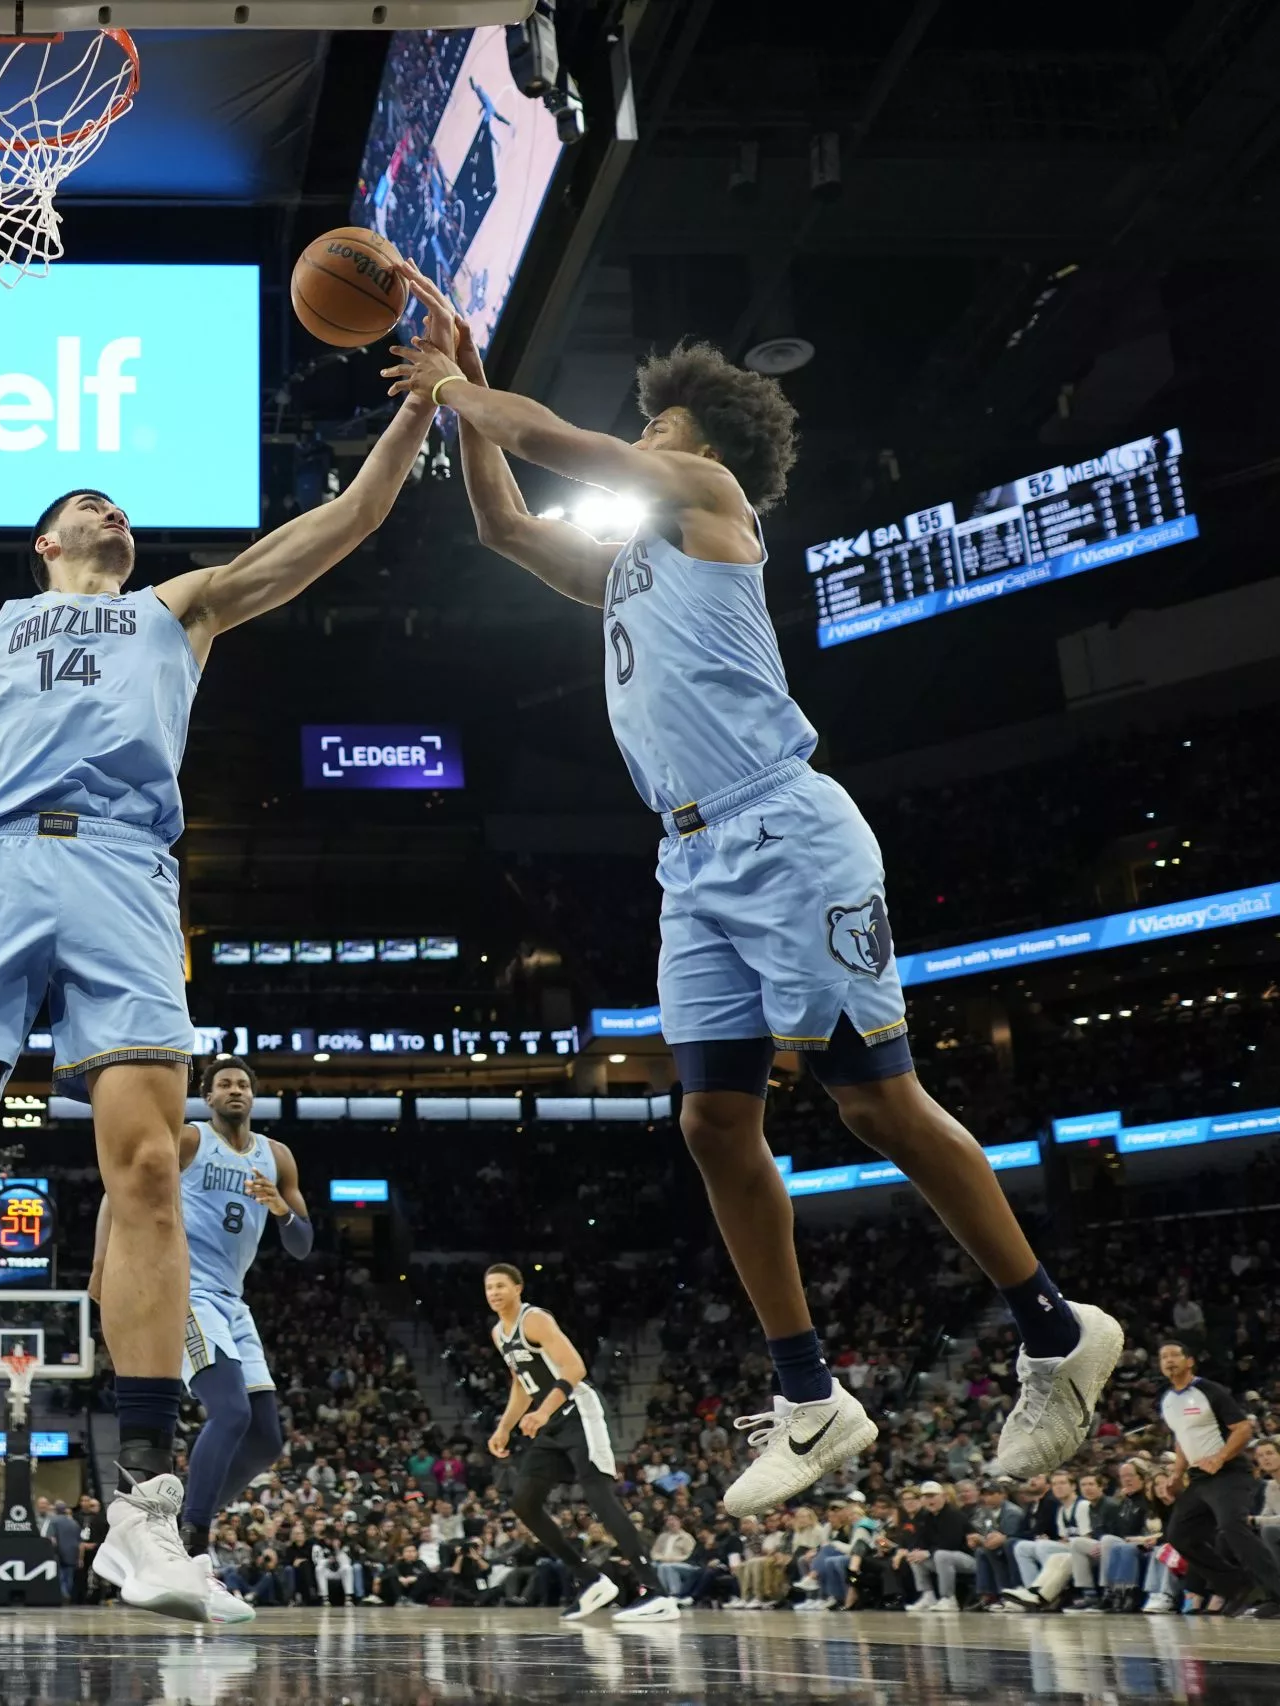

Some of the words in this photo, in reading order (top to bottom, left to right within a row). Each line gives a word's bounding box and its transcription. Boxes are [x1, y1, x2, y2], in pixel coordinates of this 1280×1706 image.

[328, 242, 393, 296] Wilson
[1066, 455, 1110, 485] MEM
[1028, 474, 1055, 497] 52
[873, 523, 902, 547] SA
[918, 510, 942, 532] 55
[8, 605, 136, 654] GRIZZLIES
[610, 620, 634, 685] 0
[36, 648, 101, 691] 14
[338, 746, 426, 766] LEDGER
[1138, 892, 1272, 934] VictoryCapital
[991, 946, 1018, 960] Your
[1020, 939, 1056, 955] Home
[1056, 931, 1091, 948] Team
[257, 1034, 282, 1049] PF
[319, 1034, 363, 1049] FG%
[399, 1035, 424, 1049] TO
[1, 1216, 40, 1246] 24
[223, 1202, 245, 1234] 8
